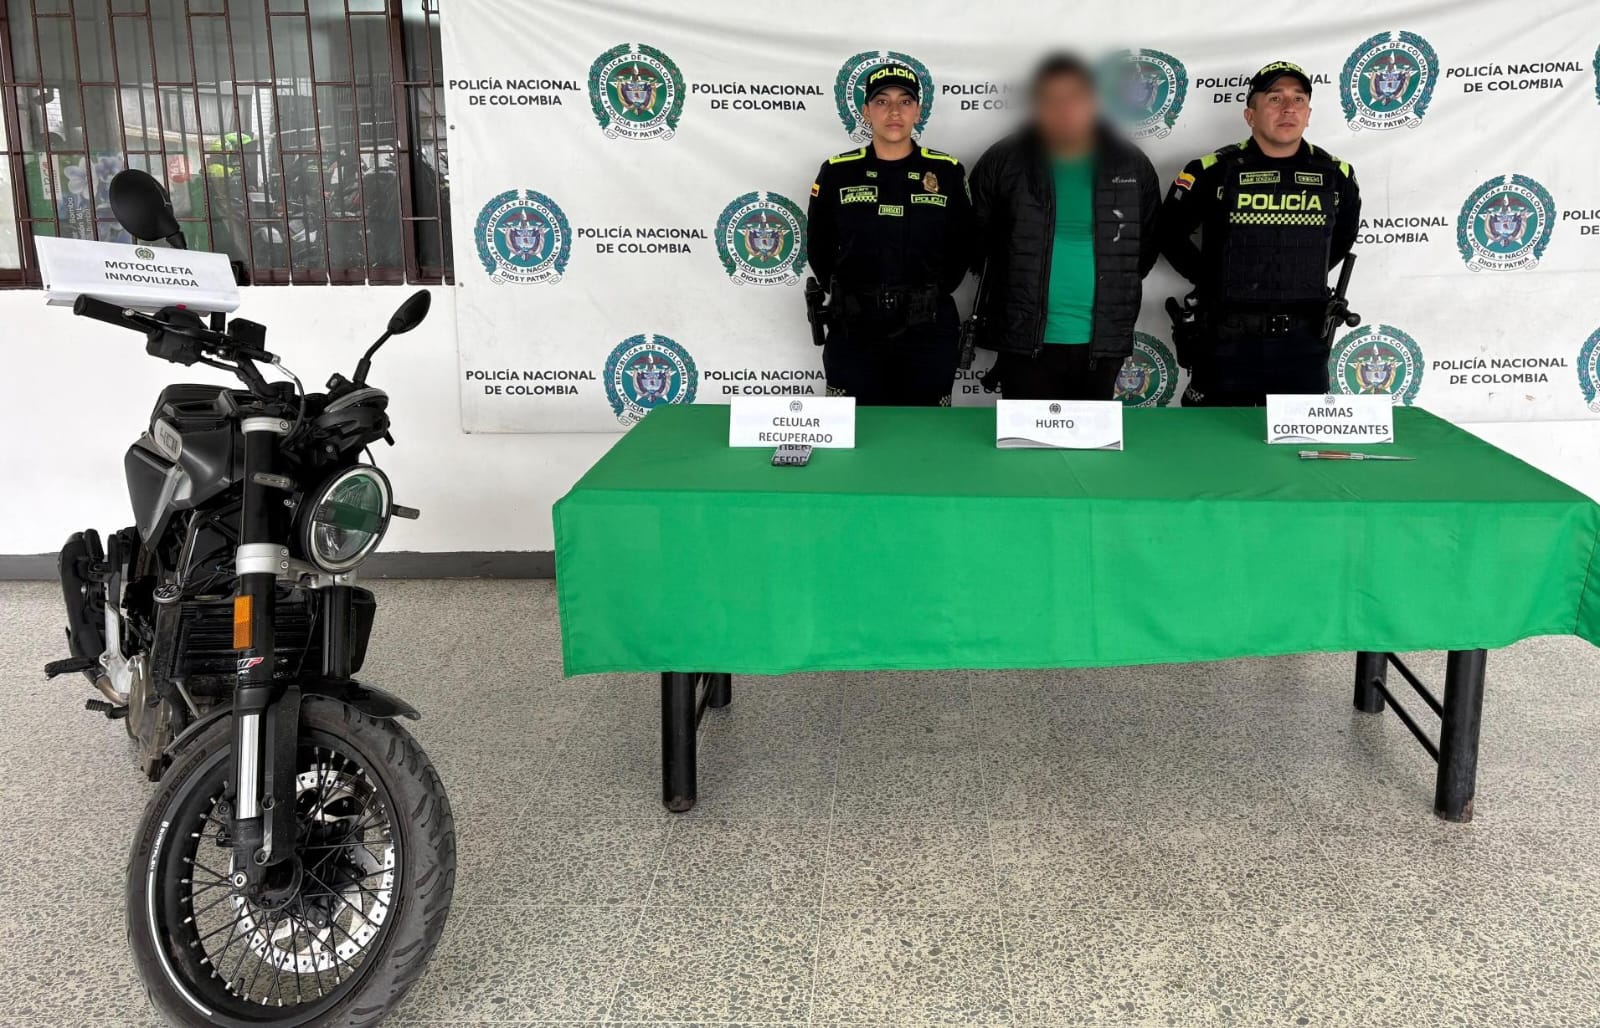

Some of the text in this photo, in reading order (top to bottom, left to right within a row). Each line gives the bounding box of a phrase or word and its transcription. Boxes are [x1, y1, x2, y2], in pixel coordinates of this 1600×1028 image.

[1352, 48, 1381, 88] REPUBLICA
[1407, 46, 1427, 86] COLOMBIA
[1446, 61, 1583, 78] POLICÍA NACIONAL
[601, 58, 624, 96] REPUBLICA
[649, 59, 674, 98] COLOMBIA
[847, 62, 871, 101] REPUBLICA
[870, 67, 916, 83] POLICÍA
[1152, 59, 1175, 95] COLOMBIA
[1196, 74, 1250, 88] POLICÍA
[449, 77, 581, 90] POLICÍA NACIONAL
[692, 82, 824, 95] POLICÍA NACIONAL
[942, 82, 998, 95] POLICÍA
[1464, 78, 1563, 93] DE COLOMBIA
[469, 95, 562, 105] DE COLOMBIA
[1214, 93, 1232, 103] DE
[711, 100, 806, 110] DE COLOMBIA
[961, 100, 979, 110] DE
[1384, 94, 1420, 118] NACIONAL
[640, 107, 670, 128] NACIONAL
[1384, 116, 1410, 128] PATRIA
[640, 127, 665, 138] PATRIA
[860, 130, 873, 138] DIO
[1237, 190, 1322, 211] POLICÍA
[1468, 190, 1496, 230] REPUBLICA
[1520, 189, 1544, 227] COLOMBIA
[488, 204, 513, 242] REPUBLICA
[536, 204, 560, 243] COLOMBIA
[728, 206, 752, 245] REPUBLICA
[777, 207, 800, 245] COLOMBIA
[1373, 216, 1448, 228] NACIONAL
[578, 226, 708, 240] POLICÍA NACIONAL
[1355, 232, 1429, 244] COLOMBIA
[596, 242, 691, 254] DE COLOMBIA
[1505, 236, 1540, 259] NACIONAL
[105, 261, 193, 275] MOTOCICLETA
[526, 251, 559, 273] NACIONAL
[765, 252, 798, 274] NACIONAL
[1504, 258, 1529, 268] PATRIA
[105, 272, 199, 287] INMOVILIZADA
[526, 272, 552, 282] PATRIA
[765, 273, 789, 284] PATRIA
[1144, 346, 1166, 382] COLOMBIA
[1339, 340, 1363, 378] REPUBLICA
[1390, 340, 1413, 376] COLOMBIA
[1433, 357, 1568, 370] POLICÍA NACIONAL
[616, 348, 638, 385] REPUBLICA
[663, 349, 687, 385] COLOMBIA
[466, 368, 596, 381] POLICÍA NACIONAL
[704, 369, 825, 380] POLICÍA NACIONA
[1450, 373, 1548, 384] DE COLOMBIA
[485, 385, 578, 395] DE COLOMBIA
[722, 385, 814, 395] DE COLOMBIA
[963, 385, 979, 394] DE
[1308, 407, 1353, 417] ARMAS
[773, 417, 820, 427] CELULAR
[1036, 419, 1074, 428] HURTO
[1273, 424, 1389, 435] CORTOPONZANTES
[759, 432, 832, 443] RECUPERADO
